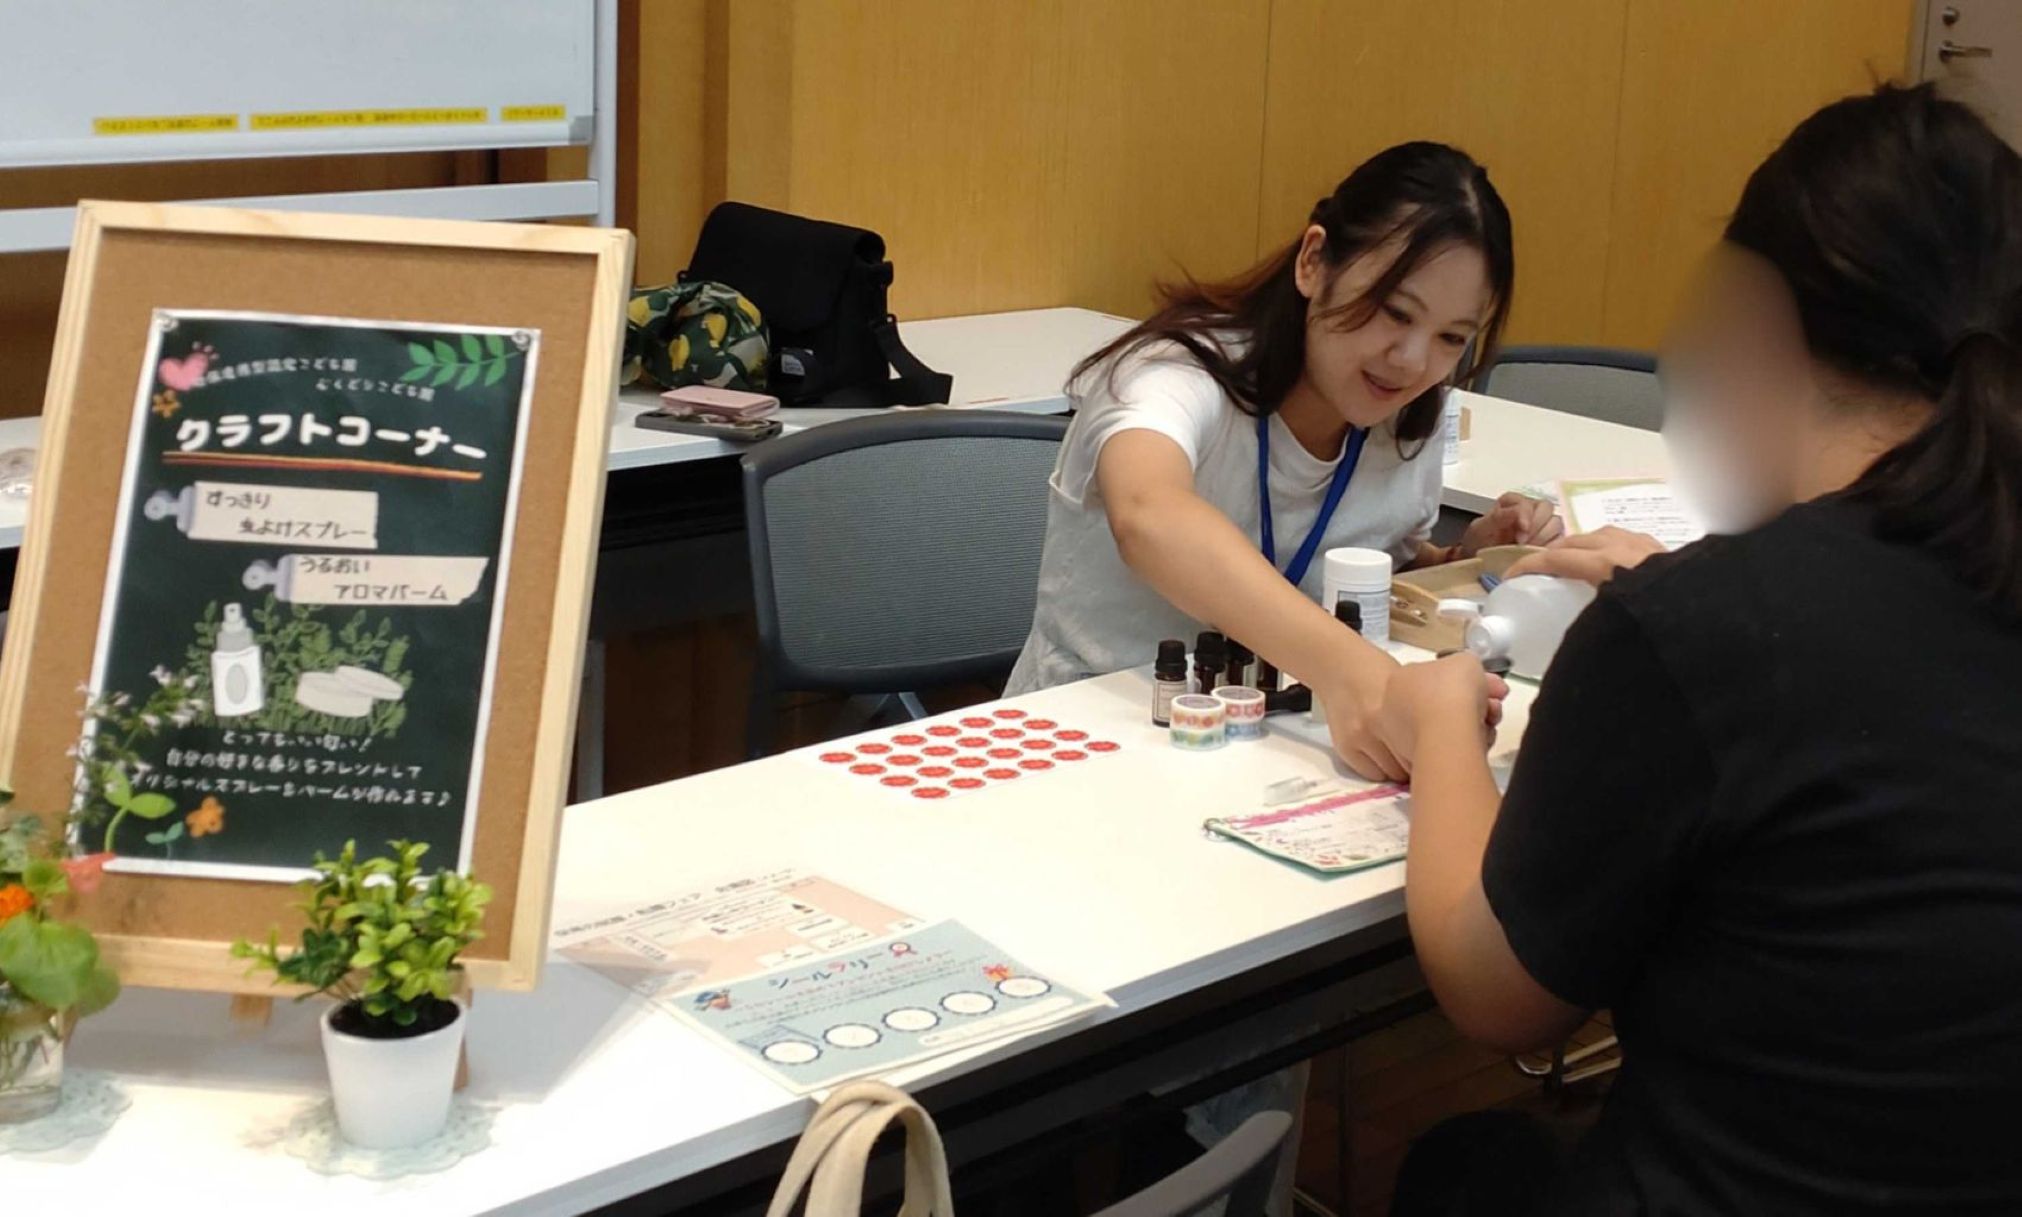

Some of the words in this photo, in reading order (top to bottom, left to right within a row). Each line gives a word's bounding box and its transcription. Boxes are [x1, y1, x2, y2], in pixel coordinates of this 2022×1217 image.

[176, 413, 487, 459] クラフトコーナー
[205, 490, 271, 510] すっきり
[238, 519, 368, 538] 虫よけスプレー
[299, 556, 371, 574] うるおい
[333, 583, 448, 601] アロマバーム
